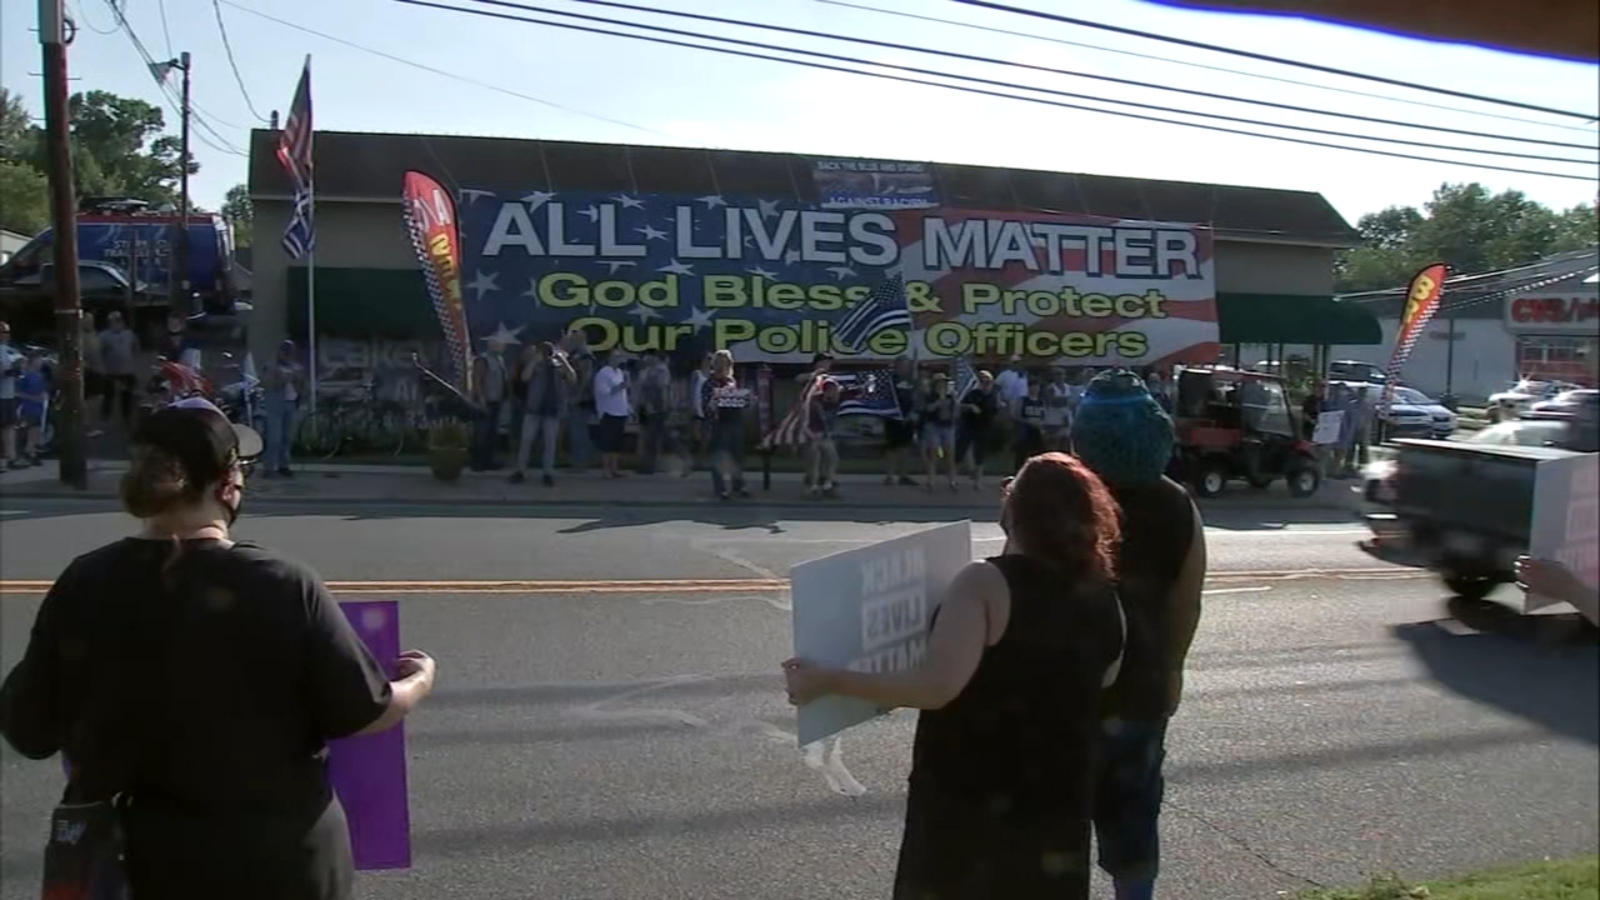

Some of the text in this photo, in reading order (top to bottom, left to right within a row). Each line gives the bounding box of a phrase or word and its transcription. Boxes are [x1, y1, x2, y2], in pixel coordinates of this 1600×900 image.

[482, 202, 647, 257] ALL
[676, 206, 898, 266] LIVES
[924, 217, 1200, 278] MATTER
[537, 273, 1167, 319] God Bless & Protect
[567, 317, 693, 353] Our
[926, 322, 1149, 357] Officers
